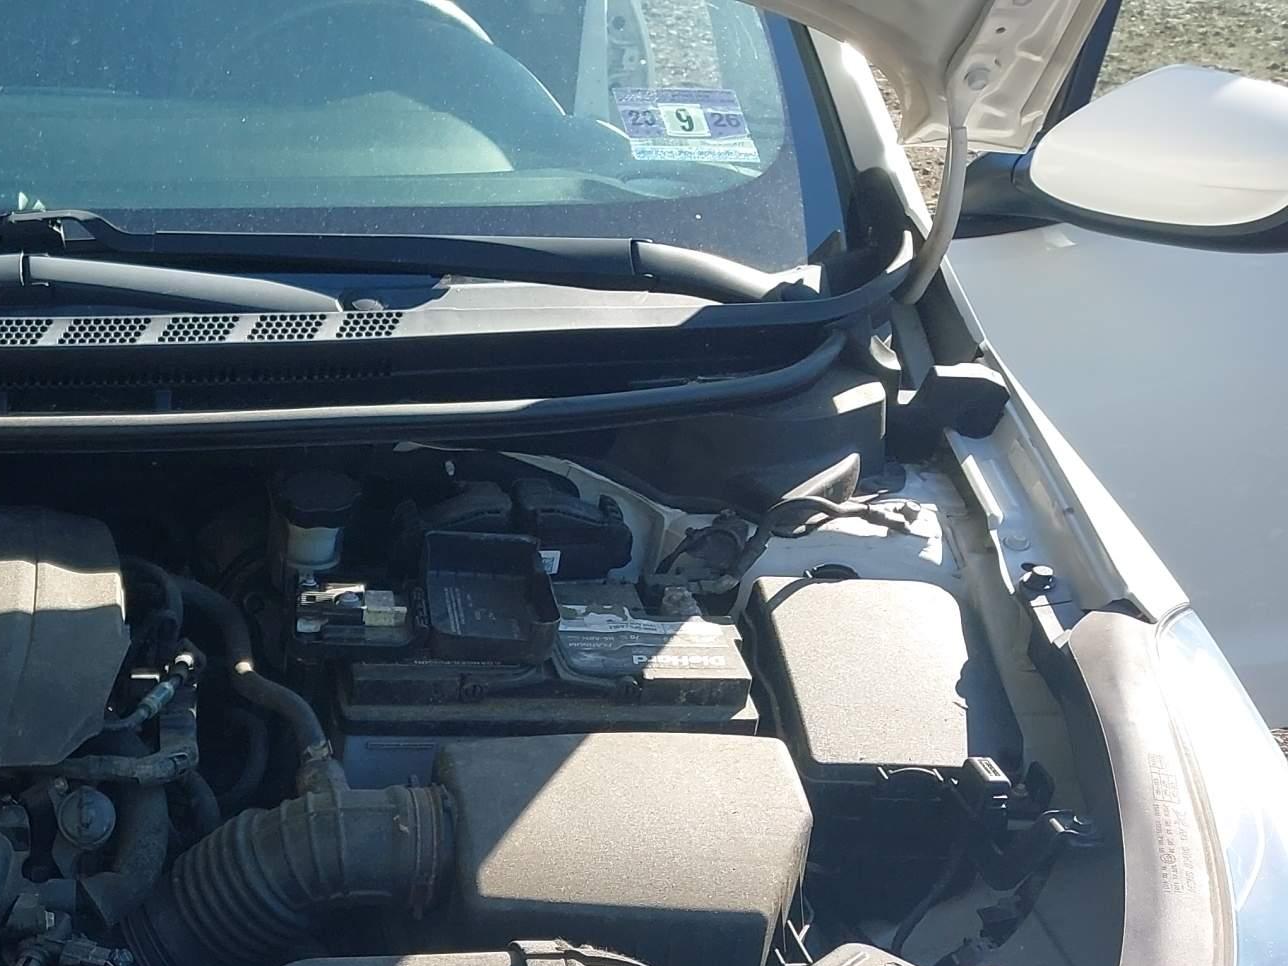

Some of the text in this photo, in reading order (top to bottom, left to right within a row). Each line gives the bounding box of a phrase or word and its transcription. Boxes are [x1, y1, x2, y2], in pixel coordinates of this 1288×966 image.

[675, 108, 695, 132] 9
[711, 112, 741, 128] 26
[632, 654, 725, 667] DieHard
